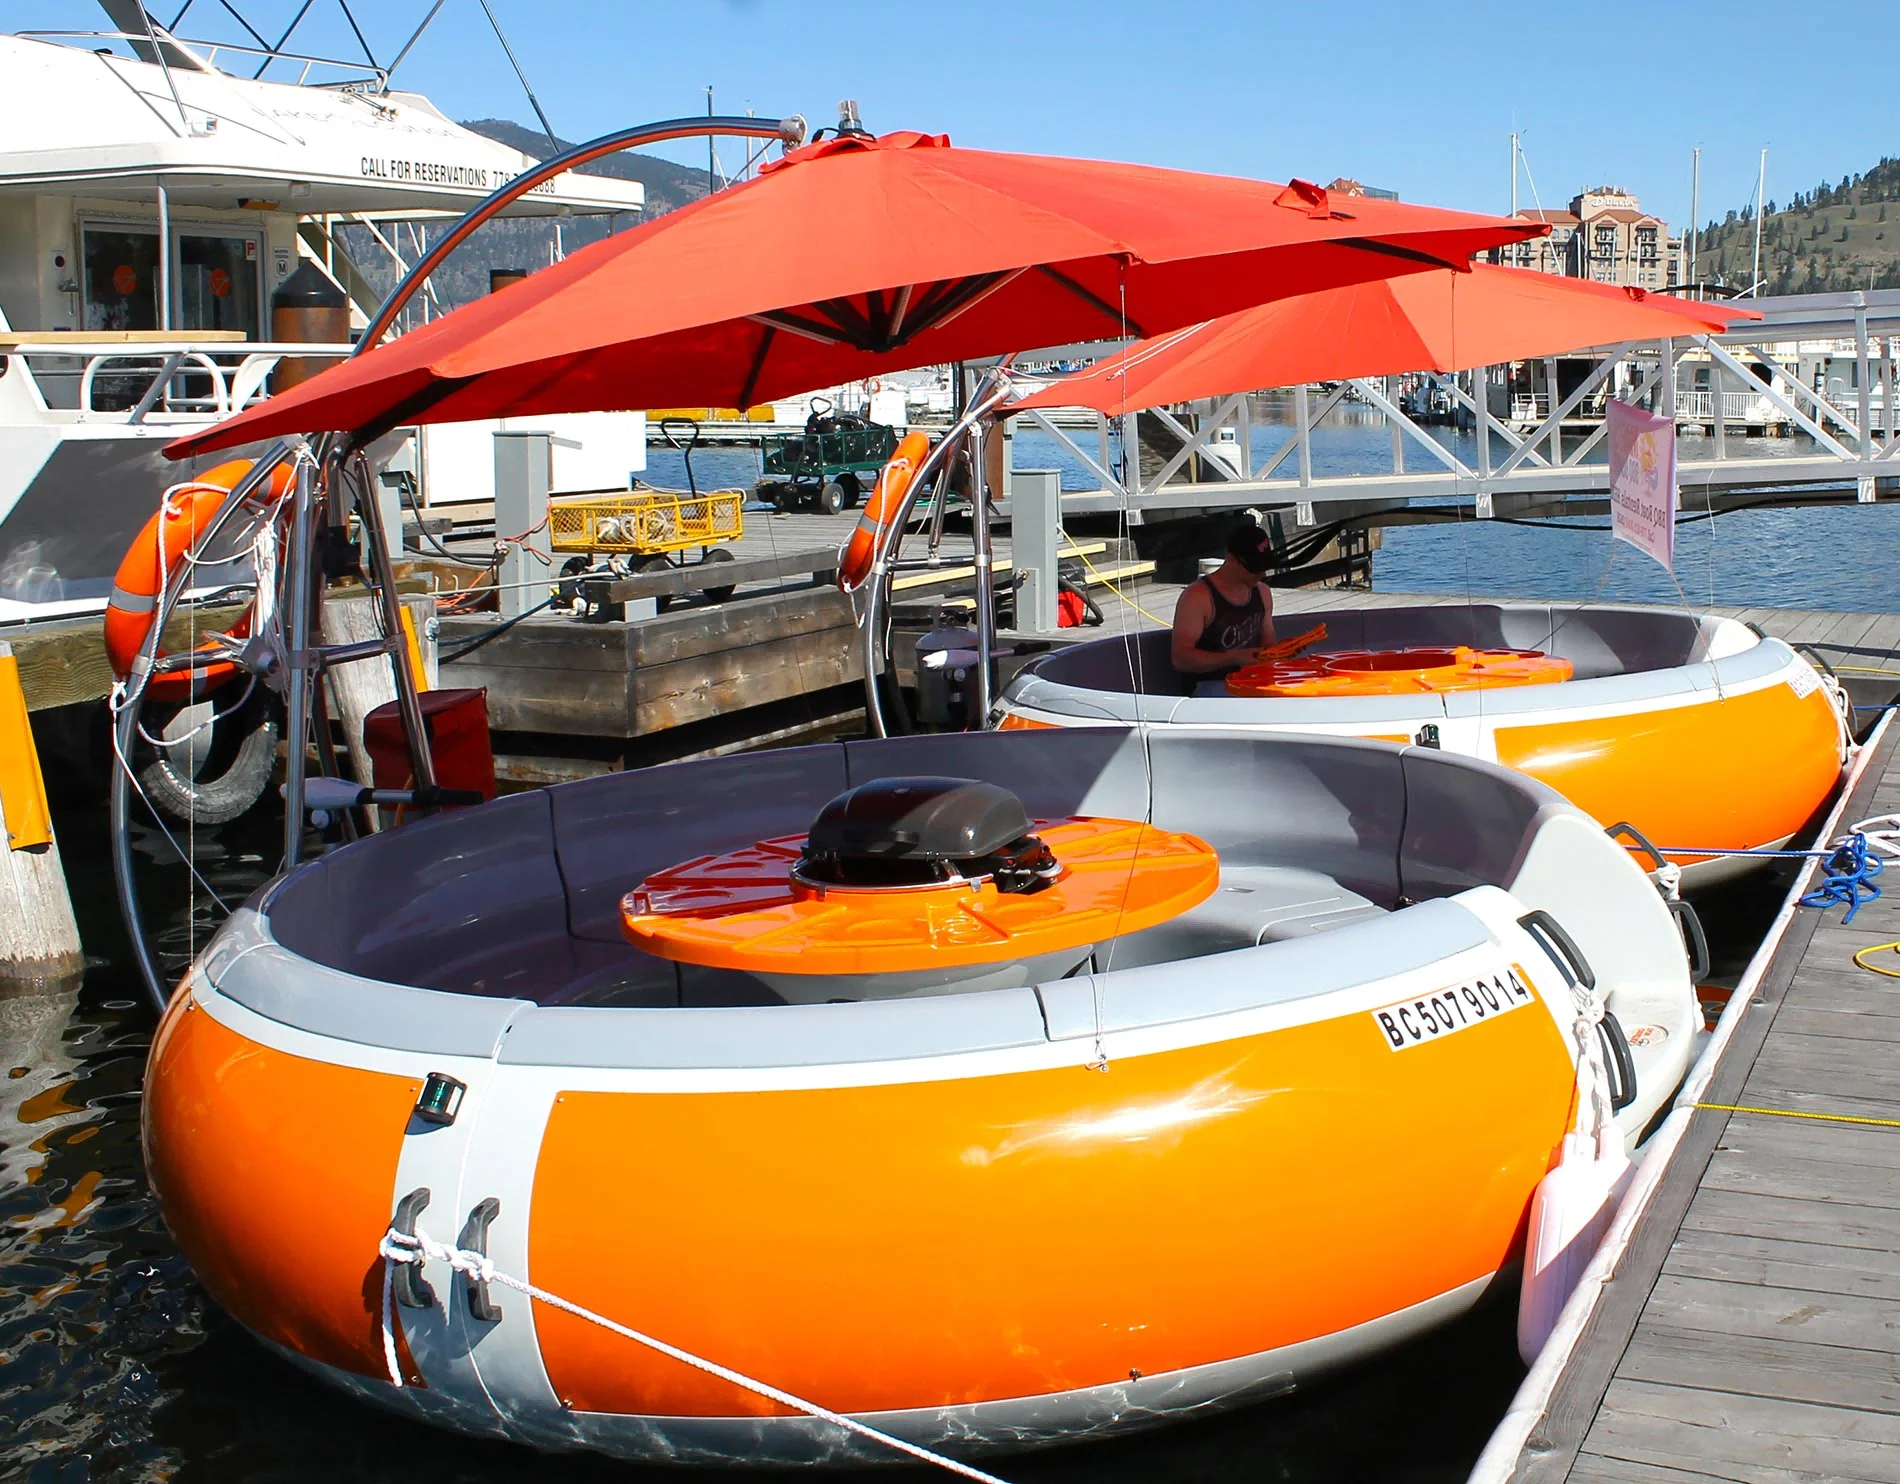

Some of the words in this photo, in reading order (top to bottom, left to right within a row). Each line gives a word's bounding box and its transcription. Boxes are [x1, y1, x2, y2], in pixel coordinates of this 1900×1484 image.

[361, 157, 387, 178] CALL
[390, 160, 411, 181] FOR
[414, 162, 487, 187] RESERVATIONS
[1378, 970, 1528, 1047] BC5079014
